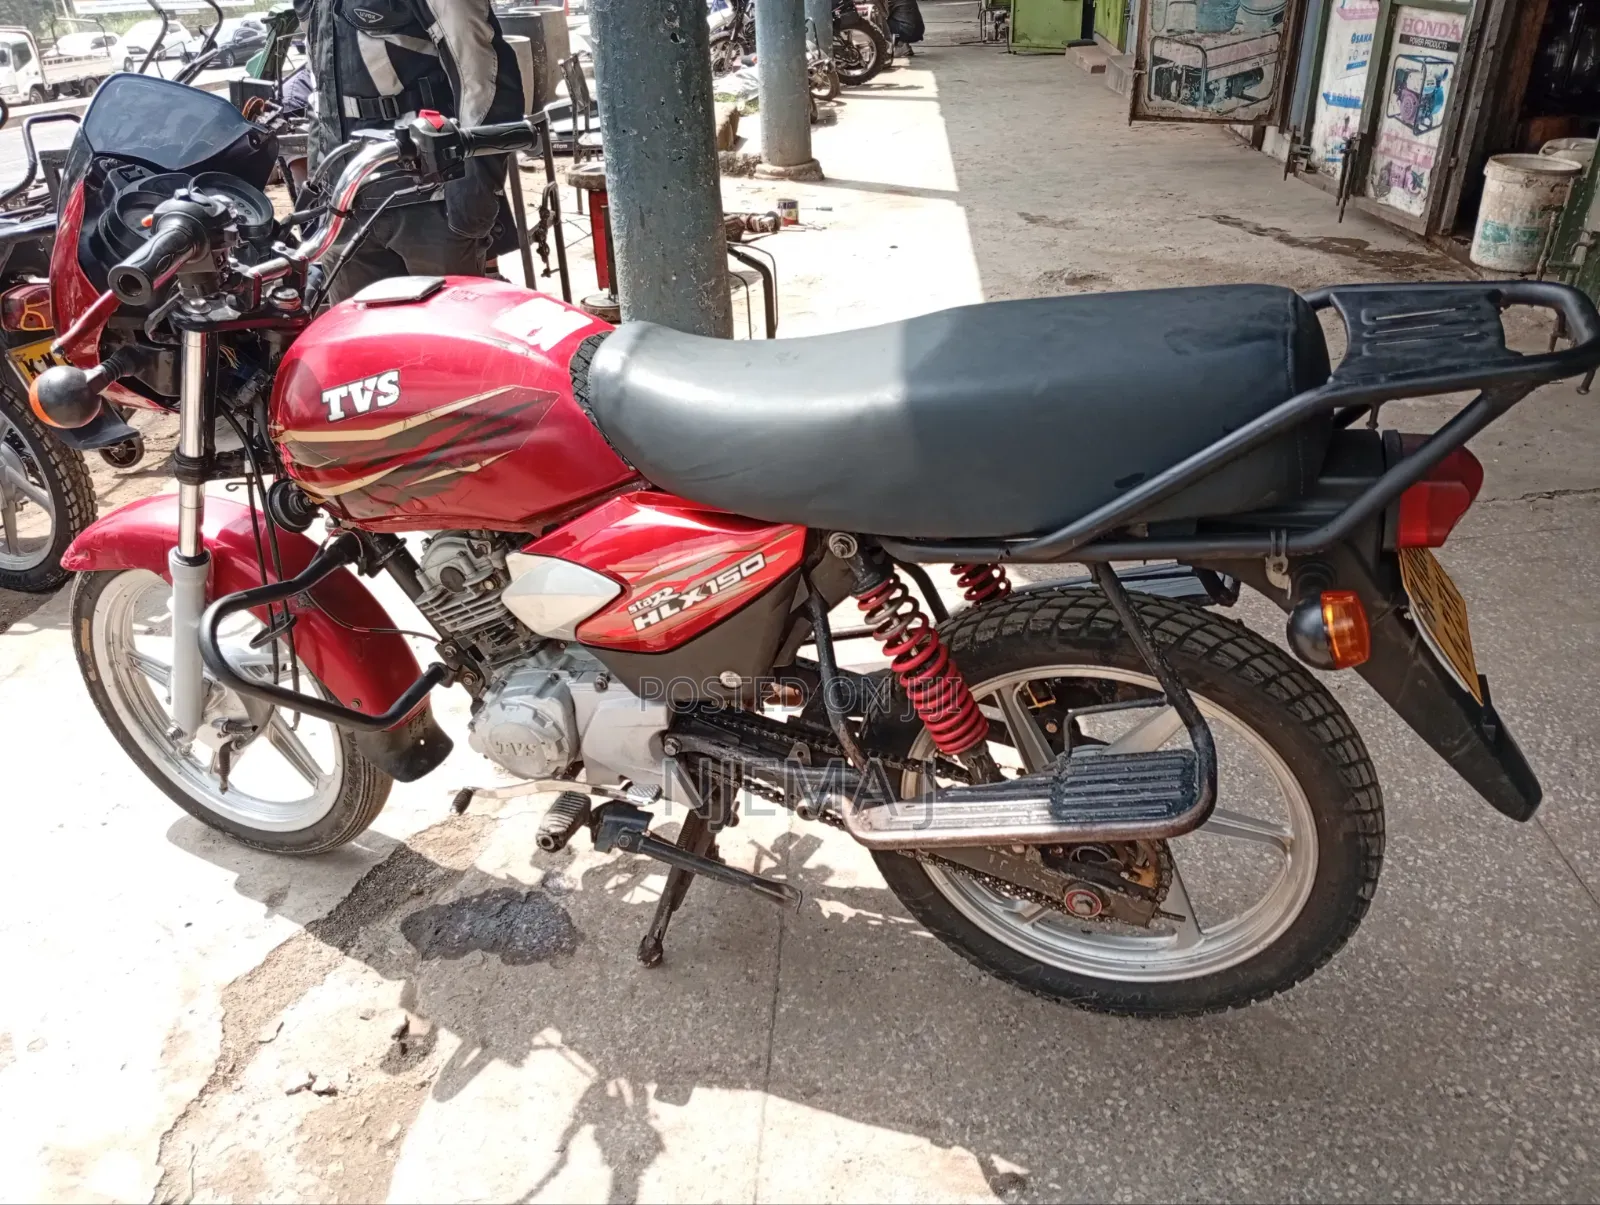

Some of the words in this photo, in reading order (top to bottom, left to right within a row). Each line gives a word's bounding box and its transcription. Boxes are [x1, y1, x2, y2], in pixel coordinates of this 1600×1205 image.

[1401, 17, 1462, 42] HONDA
[1409, 36, 1424, 47] POWER
[1424, 38, 1448, 50] PRODUCTS
[322, 370, 400, 422] TVS
